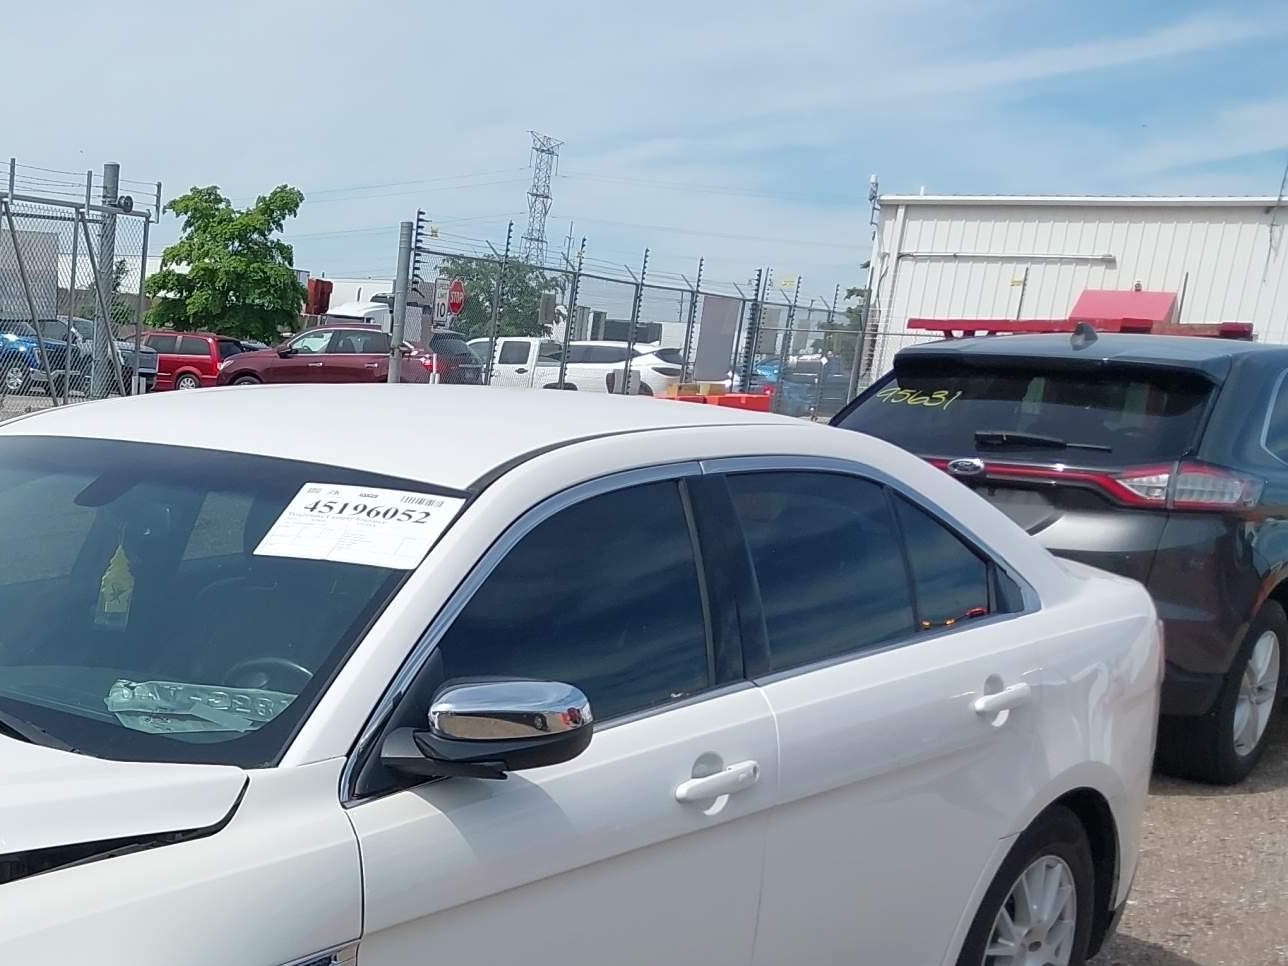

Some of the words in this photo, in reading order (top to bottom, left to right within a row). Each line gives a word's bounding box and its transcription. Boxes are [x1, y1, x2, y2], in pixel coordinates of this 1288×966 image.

[450, 291, 464, 304] STOP
[436, 302, 446, 318] 10
[876, 387, 963, 411] 95631
[304, 499, 431, 524] 45196052
